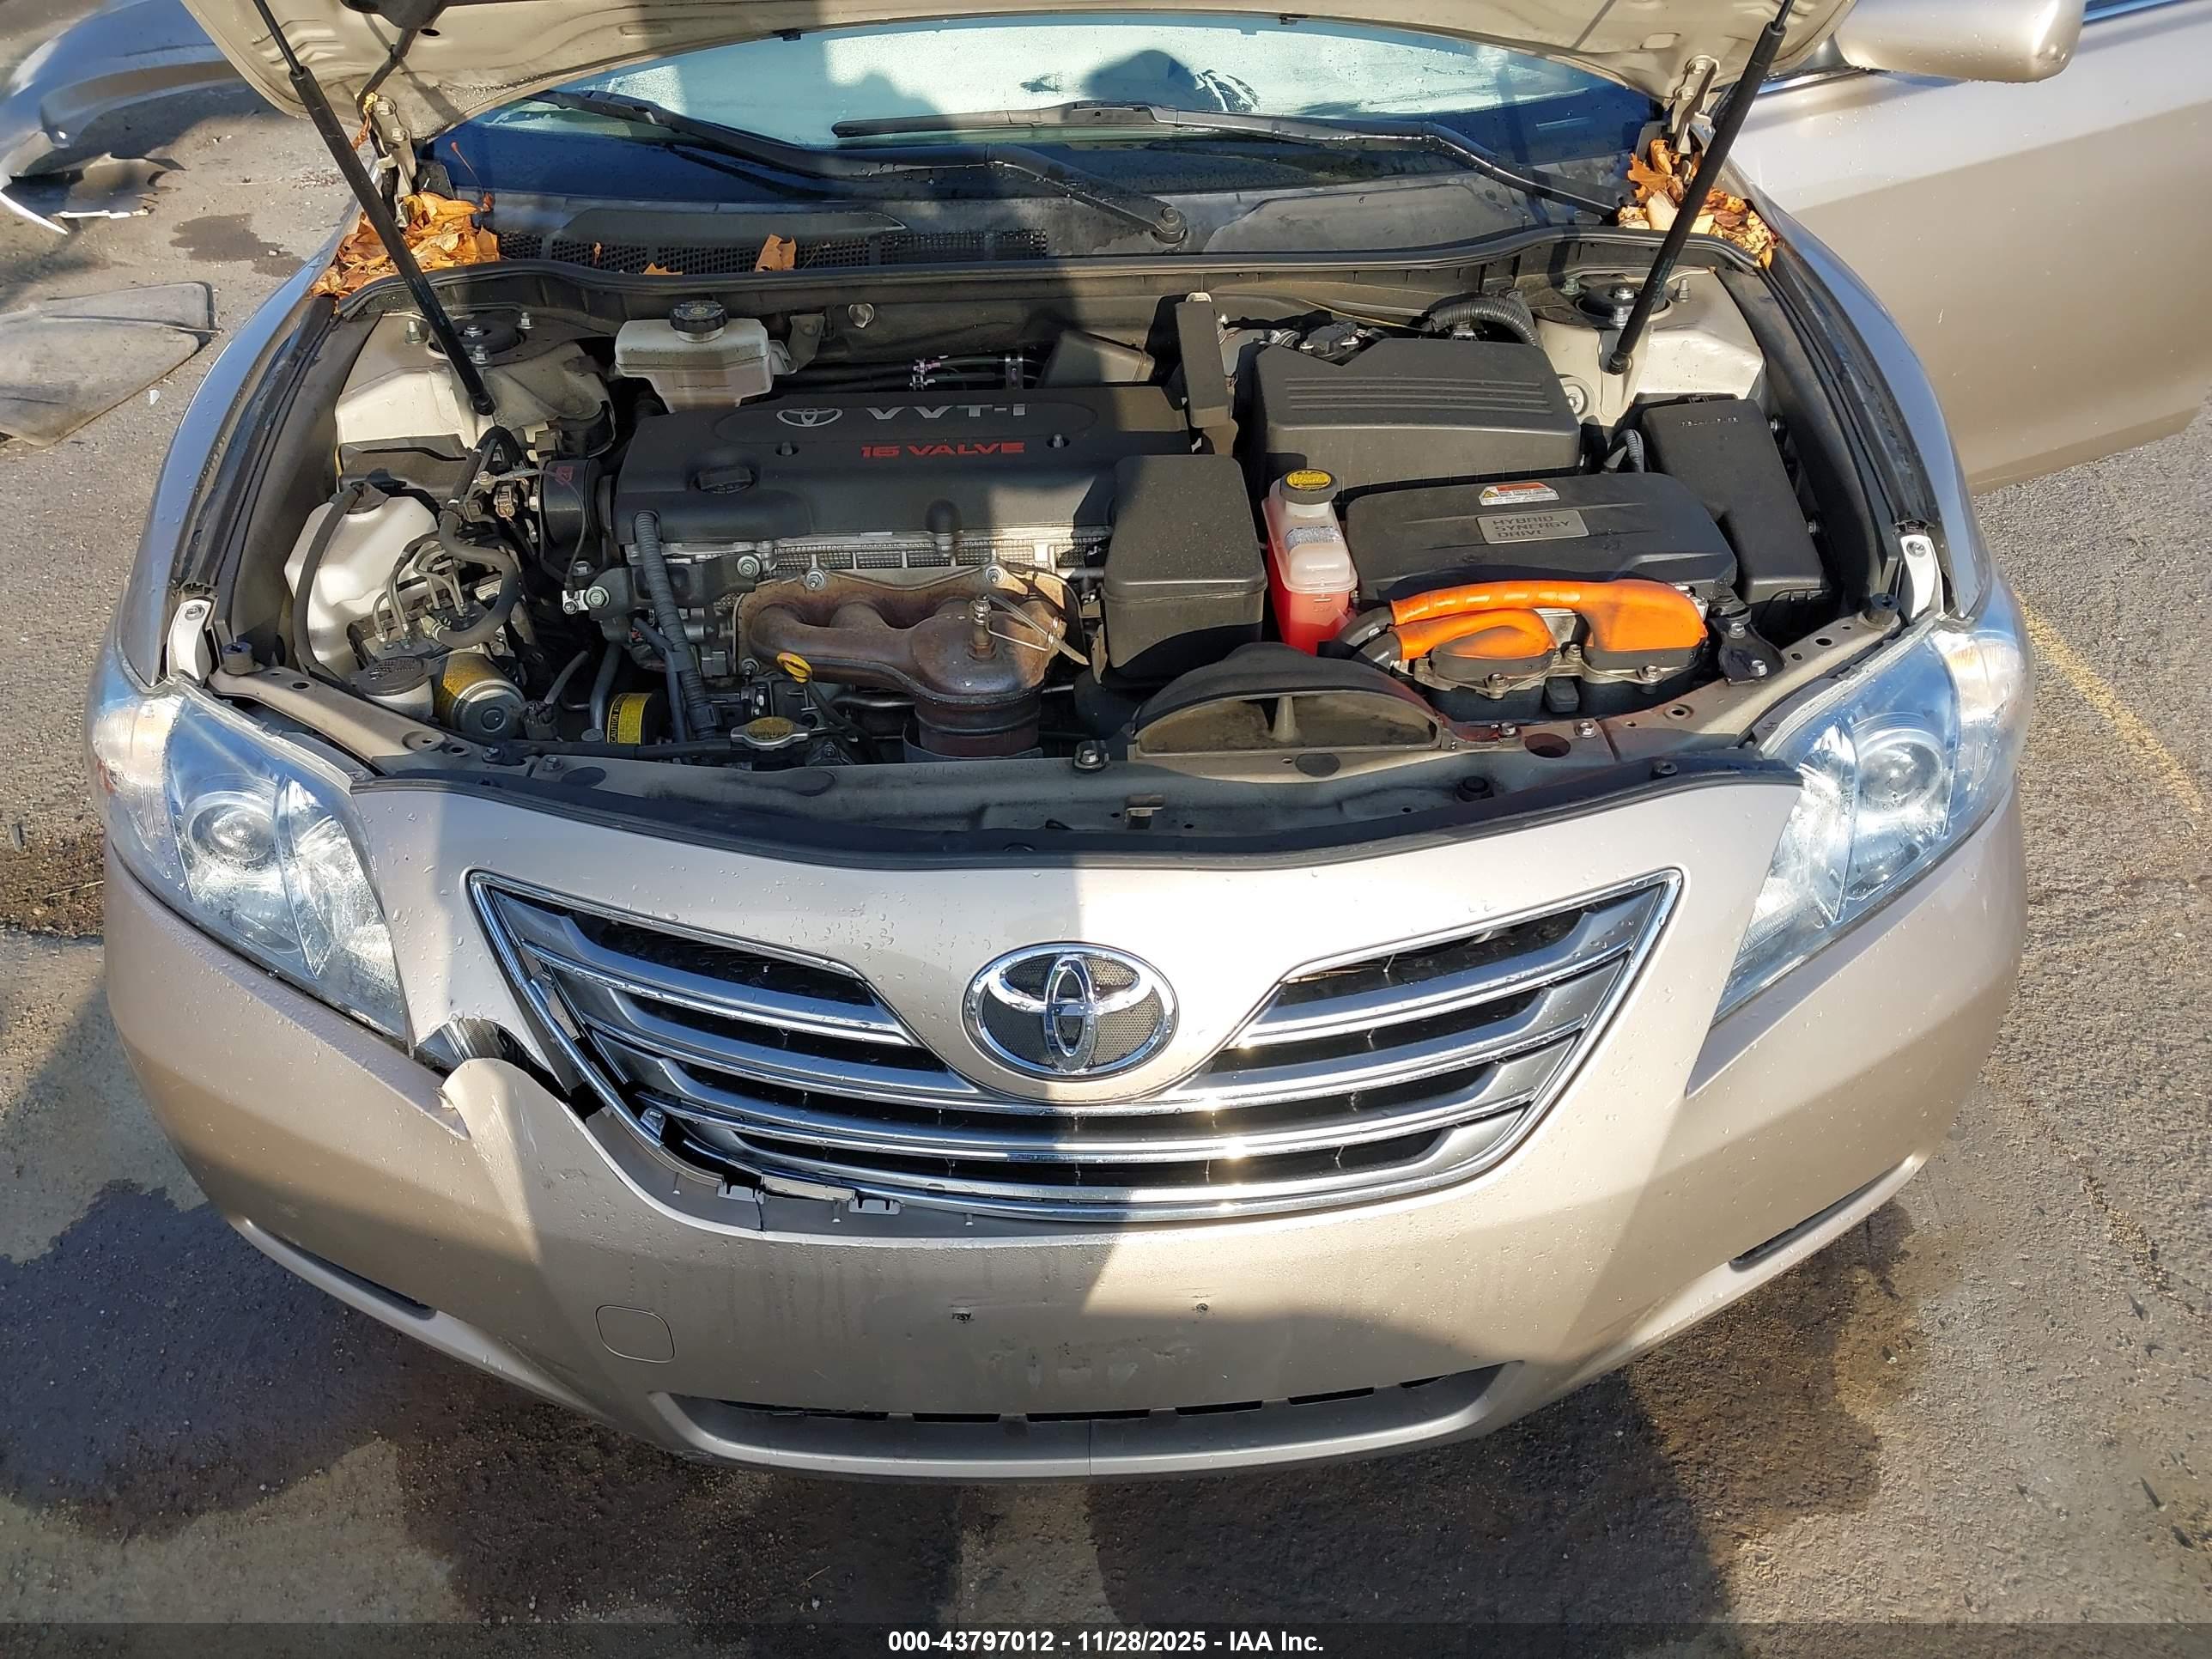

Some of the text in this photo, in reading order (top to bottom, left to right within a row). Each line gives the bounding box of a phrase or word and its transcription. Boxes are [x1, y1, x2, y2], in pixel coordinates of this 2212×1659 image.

[861, 442, 1024, 458] 16 VALVE
[1492, 515, 1553, 526] HYBRID
[1495, 520, 1570, 532] SYNERGY
[1498, 530, 1547, 538] DRIVE
